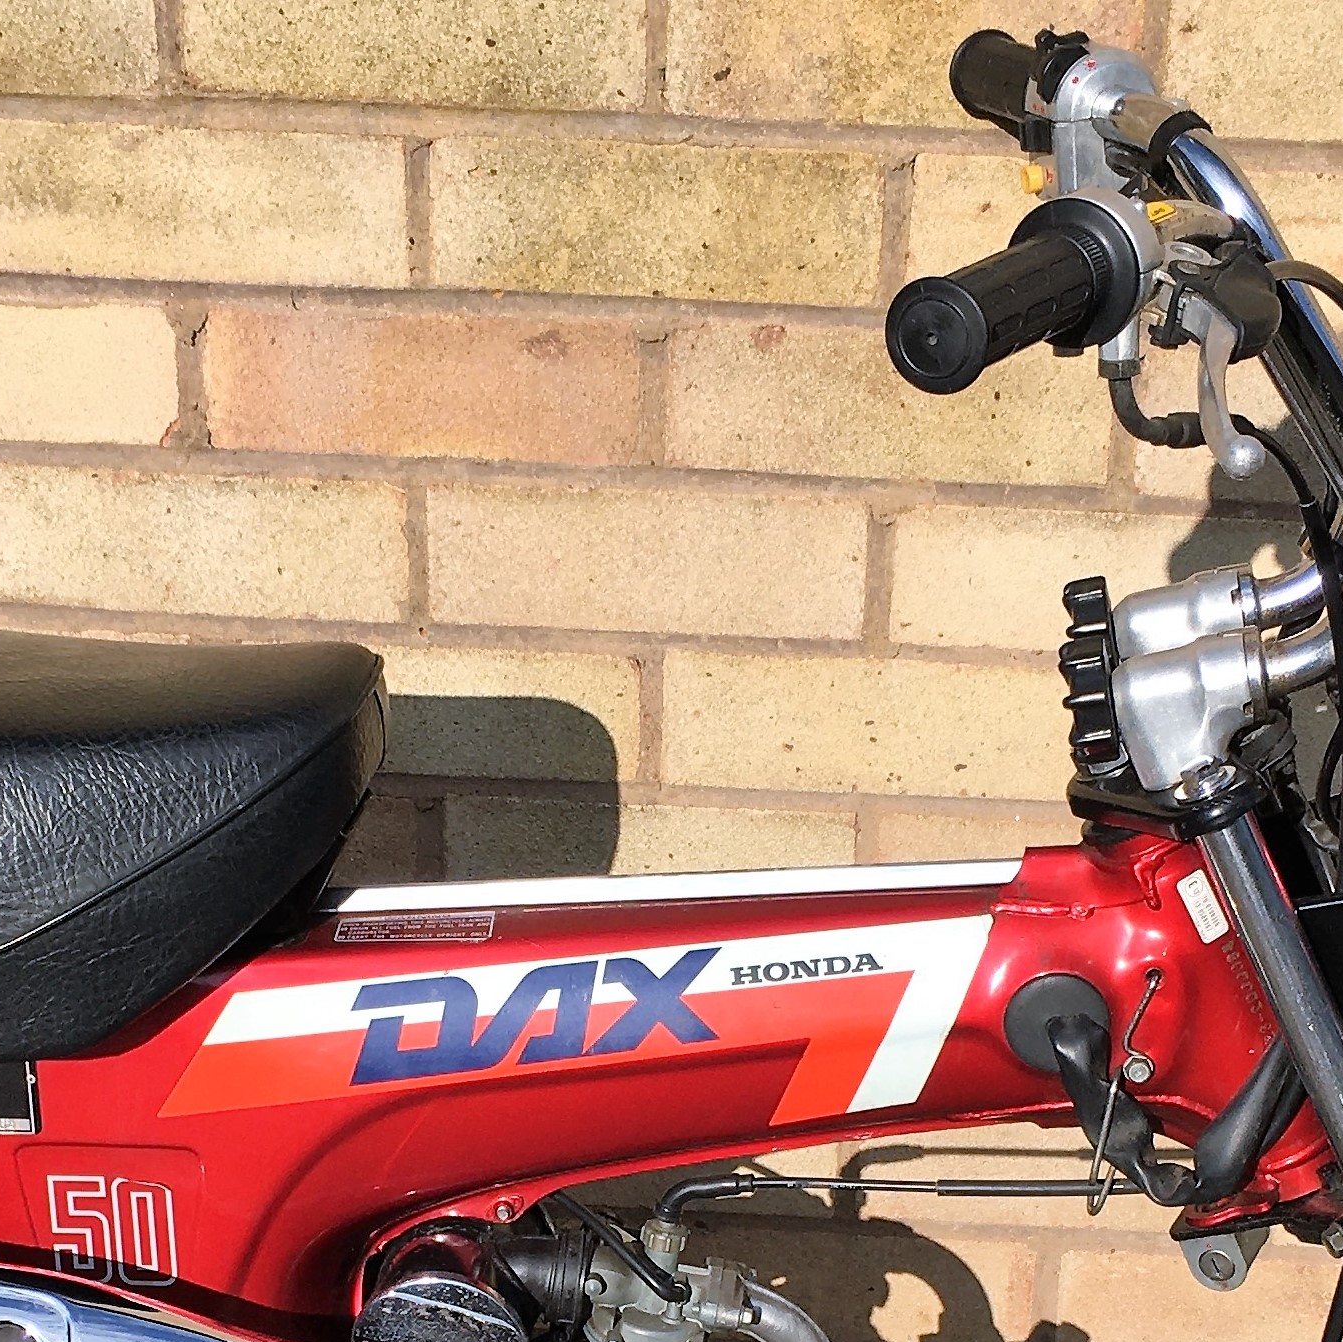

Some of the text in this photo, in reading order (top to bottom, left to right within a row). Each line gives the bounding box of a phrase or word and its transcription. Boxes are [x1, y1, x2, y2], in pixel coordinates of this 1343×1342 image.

[349, 946, 722, 1086] DAX
[730, 953, 884, 987] HONDA
[46, 1174, 179, 1287] 50
